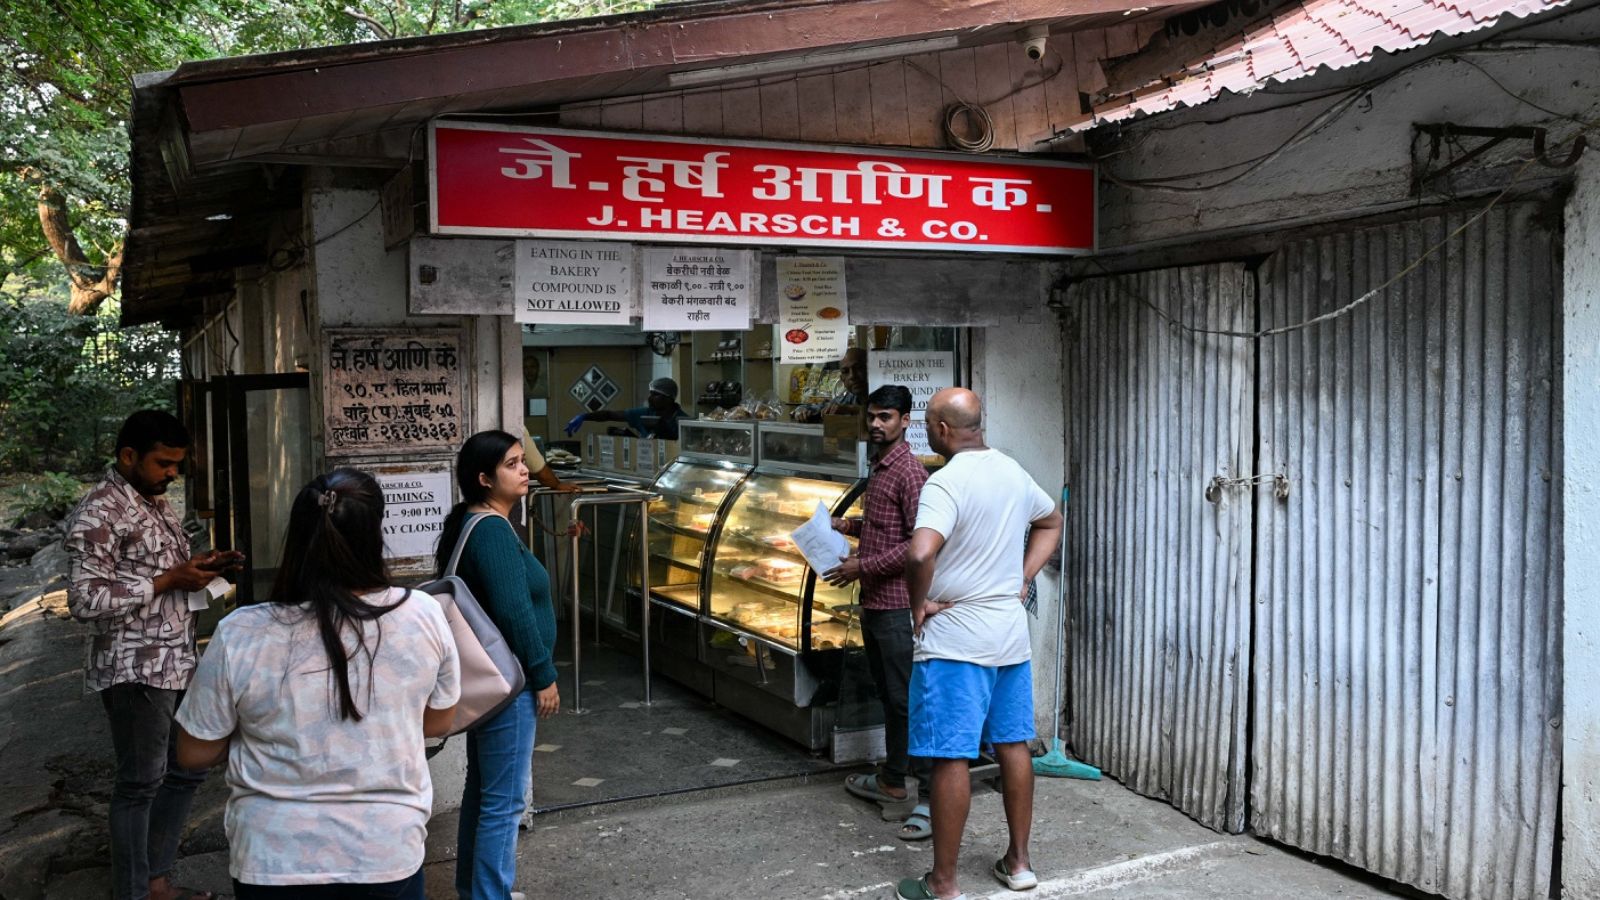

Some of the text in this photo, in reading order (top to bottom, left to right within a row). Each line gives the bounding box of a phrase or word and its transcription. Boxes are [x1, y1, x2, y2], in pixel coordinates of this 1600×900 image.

[752, 161, 952, 208] आणि
[968, 177, 1052, 213] क.
[587, 205, 989, 240] J. HEARSCH & CO.
[530, 248, 620, 260] EATING IN THE
[550, 266, 600, 277] BAKERY
[716, 265, 731, 276] वेळ
[532, 282, 617, 295] COMPOUND IS
[651, 279, 682, 291] सकाळी
[709, 279, 725, 291] रात्री
[527, 299, 621, 311] NOT ALLOWED
[661, 294, 737, 307] बेकरी मंगळवारी बंद
[687, 309, 711, 322] राहील
[383, 341, 432, 372] आणि
[879, 359, 945, 368] EATING IN THE
[893, 373, 930, 382] BAKERY
[394, 378, 420, 397] हिल
[385, 491, 434, 503] TIMINGS
[401, 508, 422, 518] 9:00
[425, 507, 442, 516] PM
